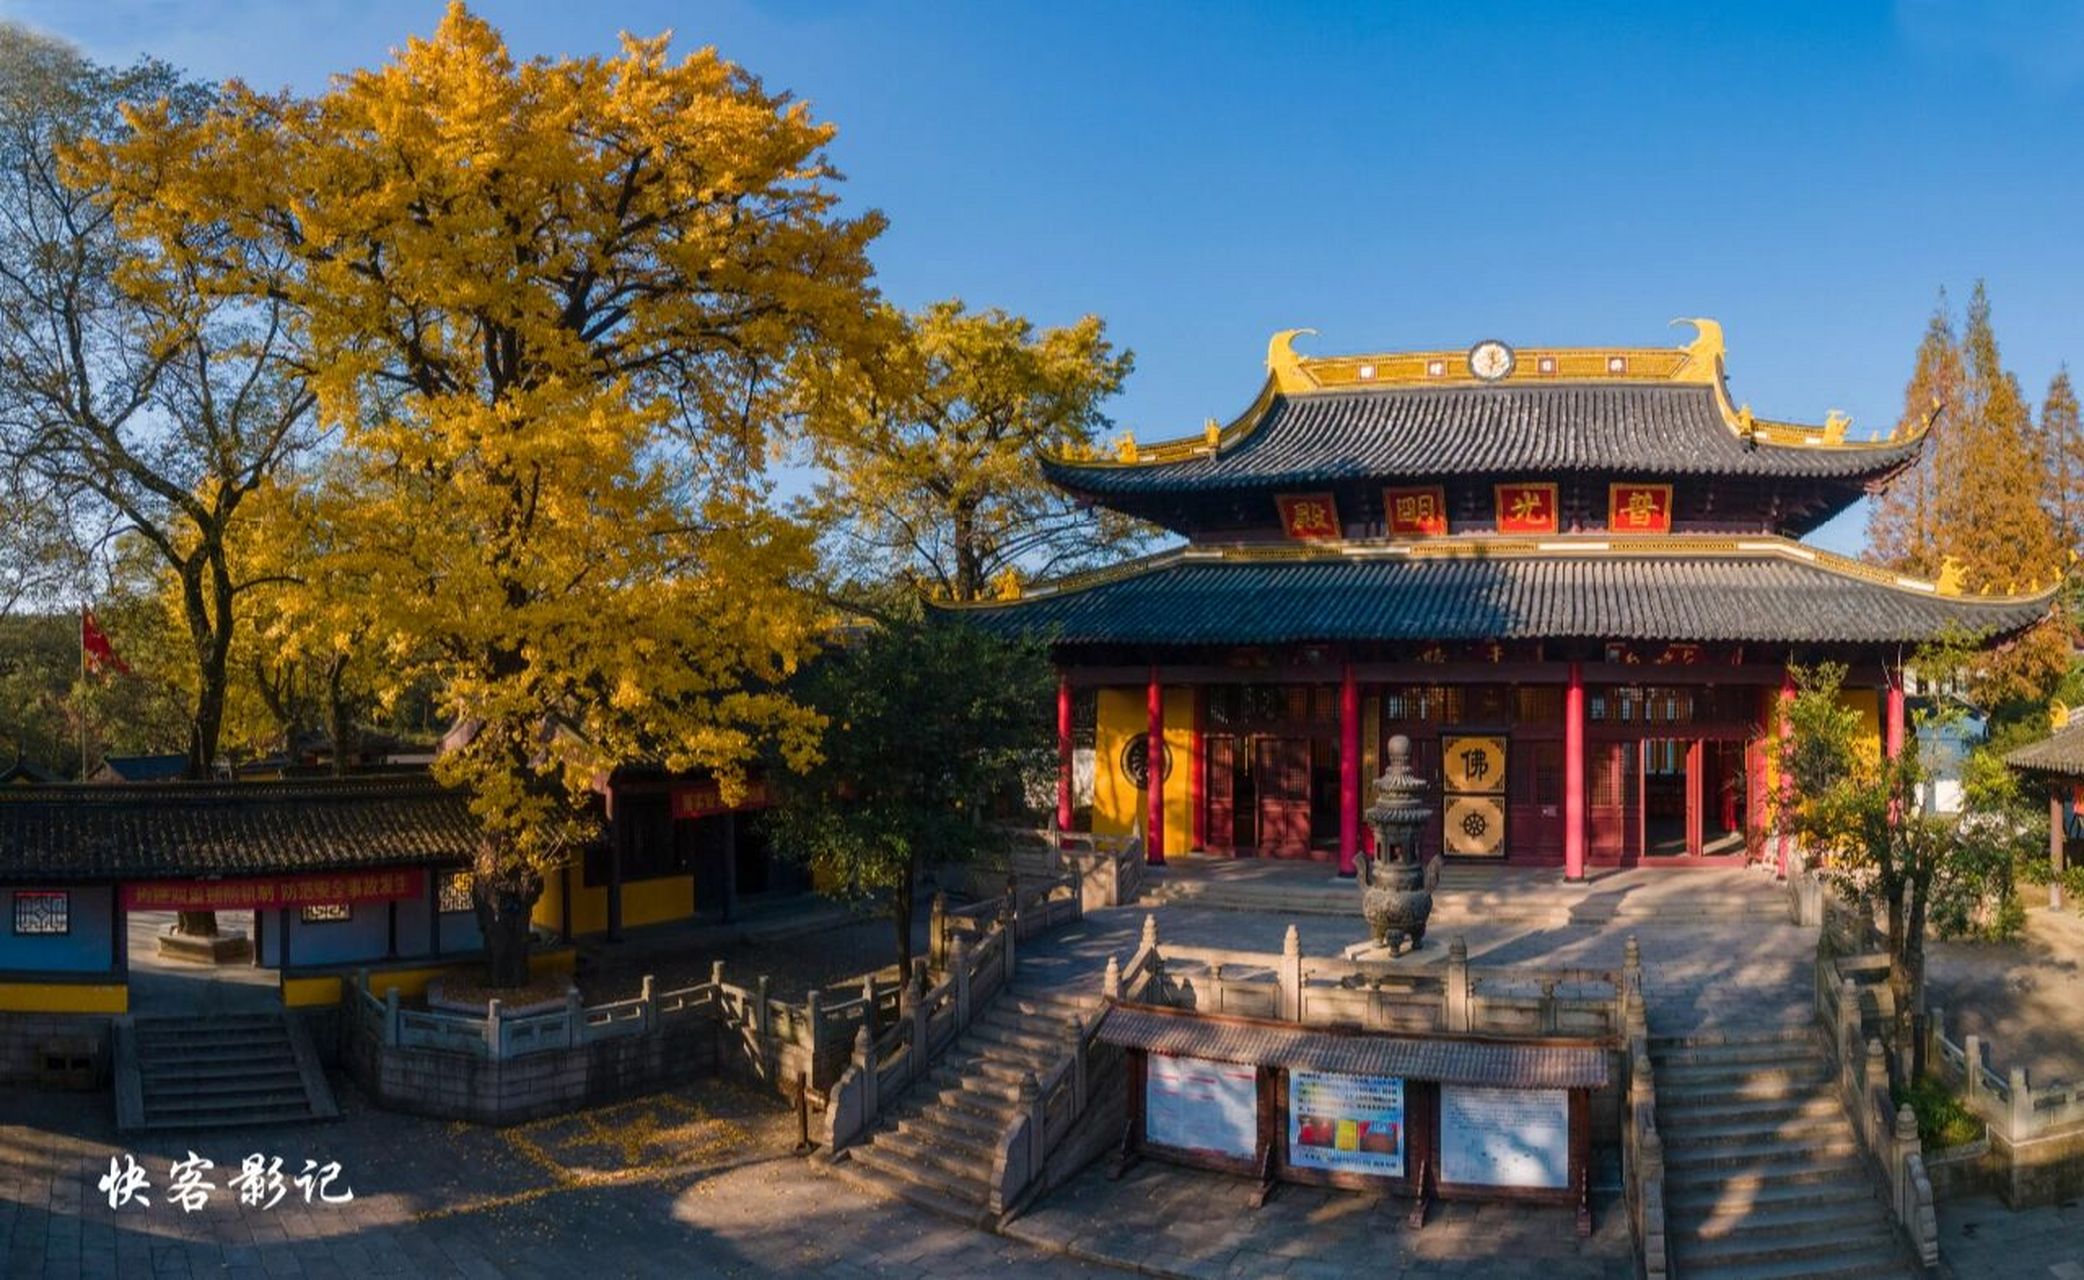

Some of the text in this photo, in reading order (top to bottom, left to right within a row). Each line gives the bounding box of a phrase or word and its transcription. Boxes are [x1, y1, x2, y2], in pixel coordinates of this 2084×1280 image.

[1293, 501, 1329, 530] 殿
[1510, 490, 1548, 525] 光
[1619, 491, 1660, 527] 普
[1460, 747, 1489, 782] 佛
